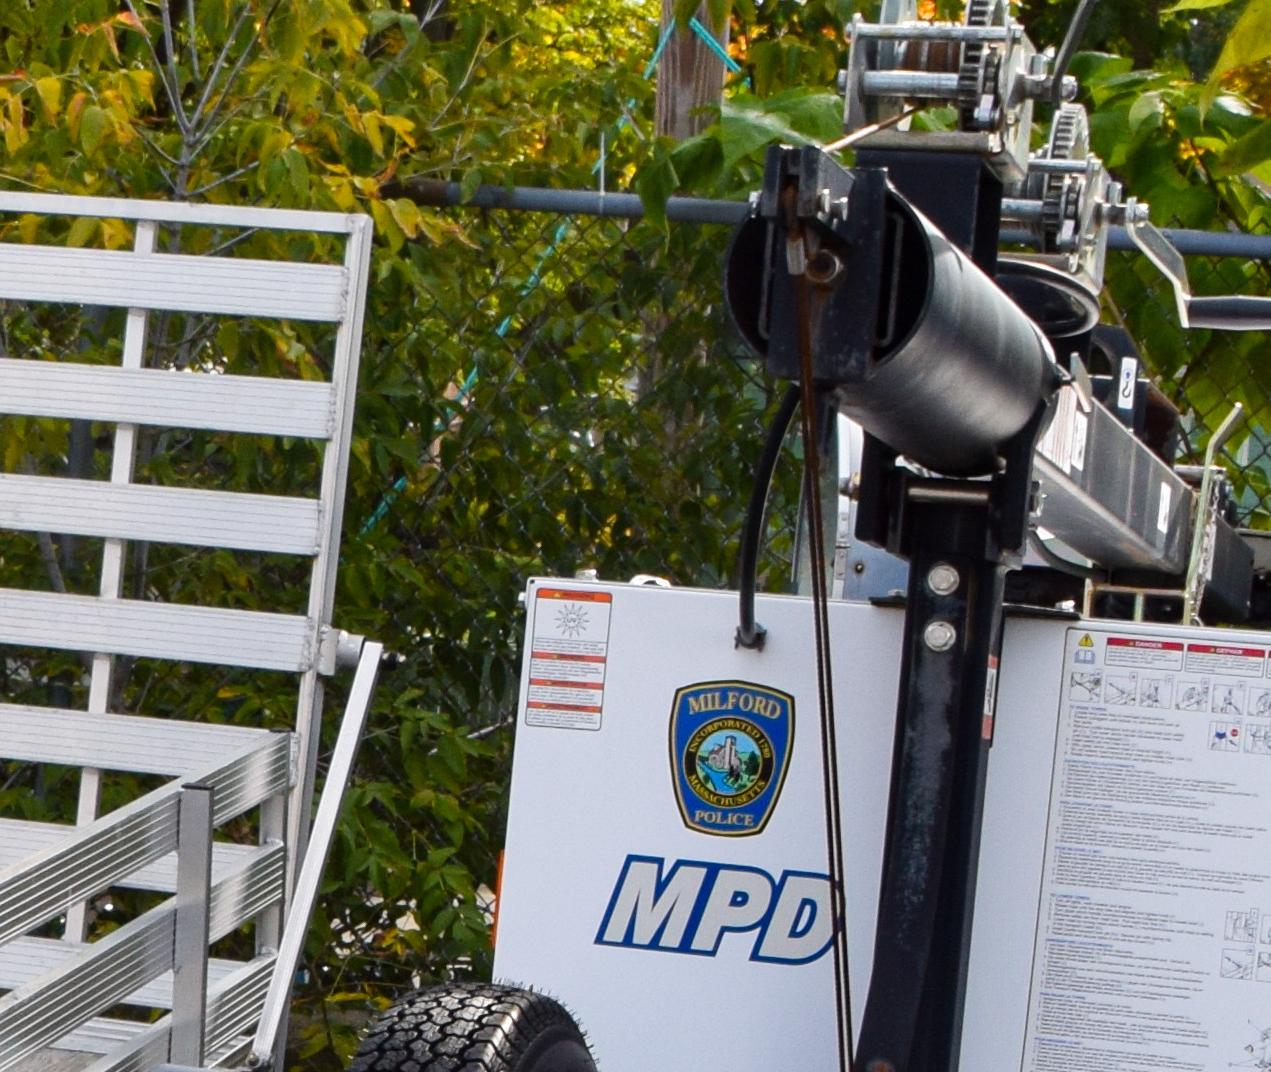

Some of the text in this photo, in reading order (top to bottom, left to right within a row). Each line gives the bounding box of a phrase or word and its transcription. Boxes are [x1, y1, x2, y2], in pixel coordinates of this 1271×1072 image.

[688, 692, 781, 719] MILFORD
[689, 720, 760, 752] INCORPORATED
[689, 775, 765, 806] MASSACHUSETTS
[695, 810, 754, 826] POLICE
[594, 854, 842, 965] MPD
